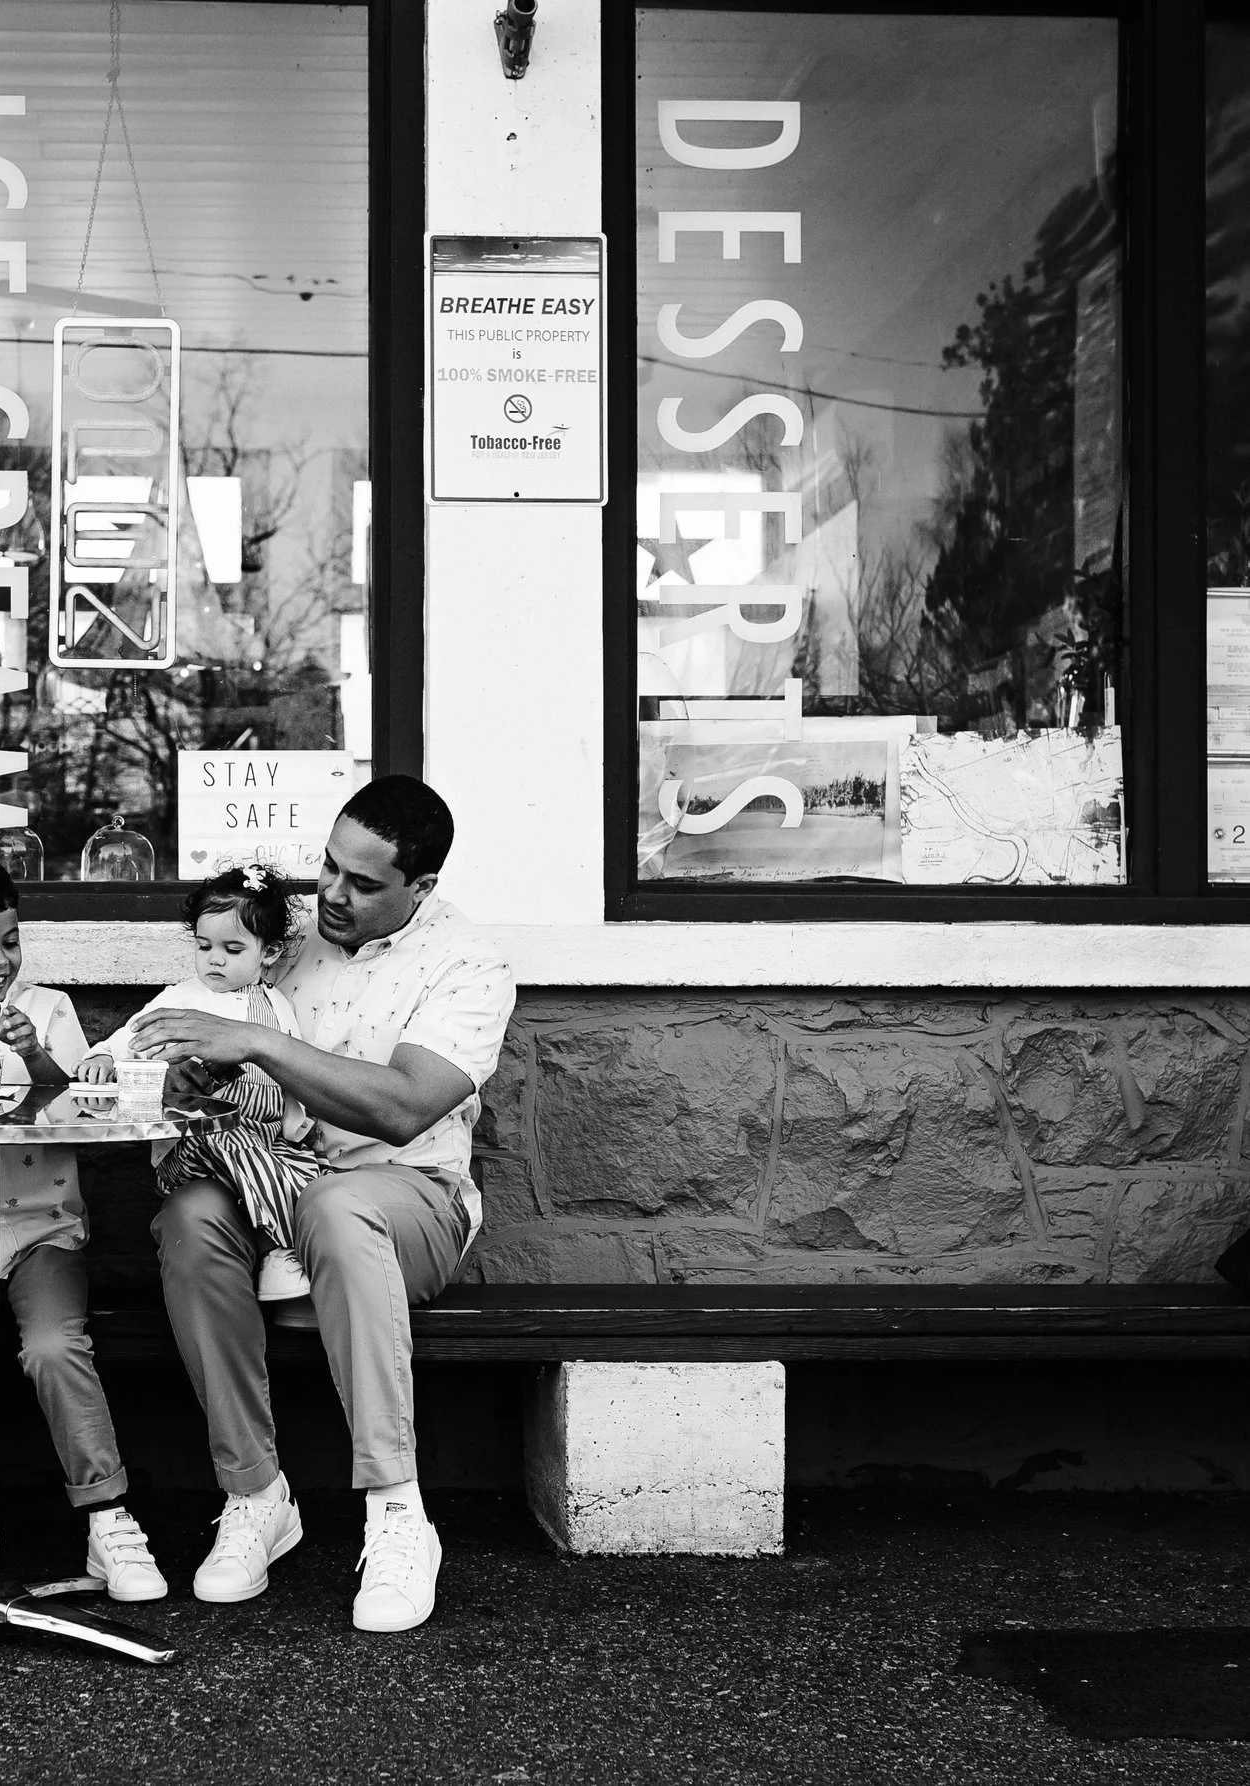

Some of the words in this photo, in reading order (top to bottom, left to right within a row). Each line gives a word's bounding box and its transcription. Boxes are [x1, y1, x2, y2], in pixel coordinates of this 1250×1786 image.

[439, 297, 536, 315] BREATHE
[541, 298, 596, 316] EASY
[447, 329, 475, 341] THIS
[478, 329, 523, 342] PUBLIC
[526, 329, 591, 342] PROPERTY
[512, 347, 522, 360] is
[437, 367, 483, 382] 100%
[486, 368, 598, 384] SMOKE-FREE
[470, 434, 562, 451] Tobacco-Free
[656, 100, 804, 835] DESSERTS
[64, 335, 169, 651] OPEN
[202, 761, 279, 788] STAY
[225, 802, 300, 829] SAFE
